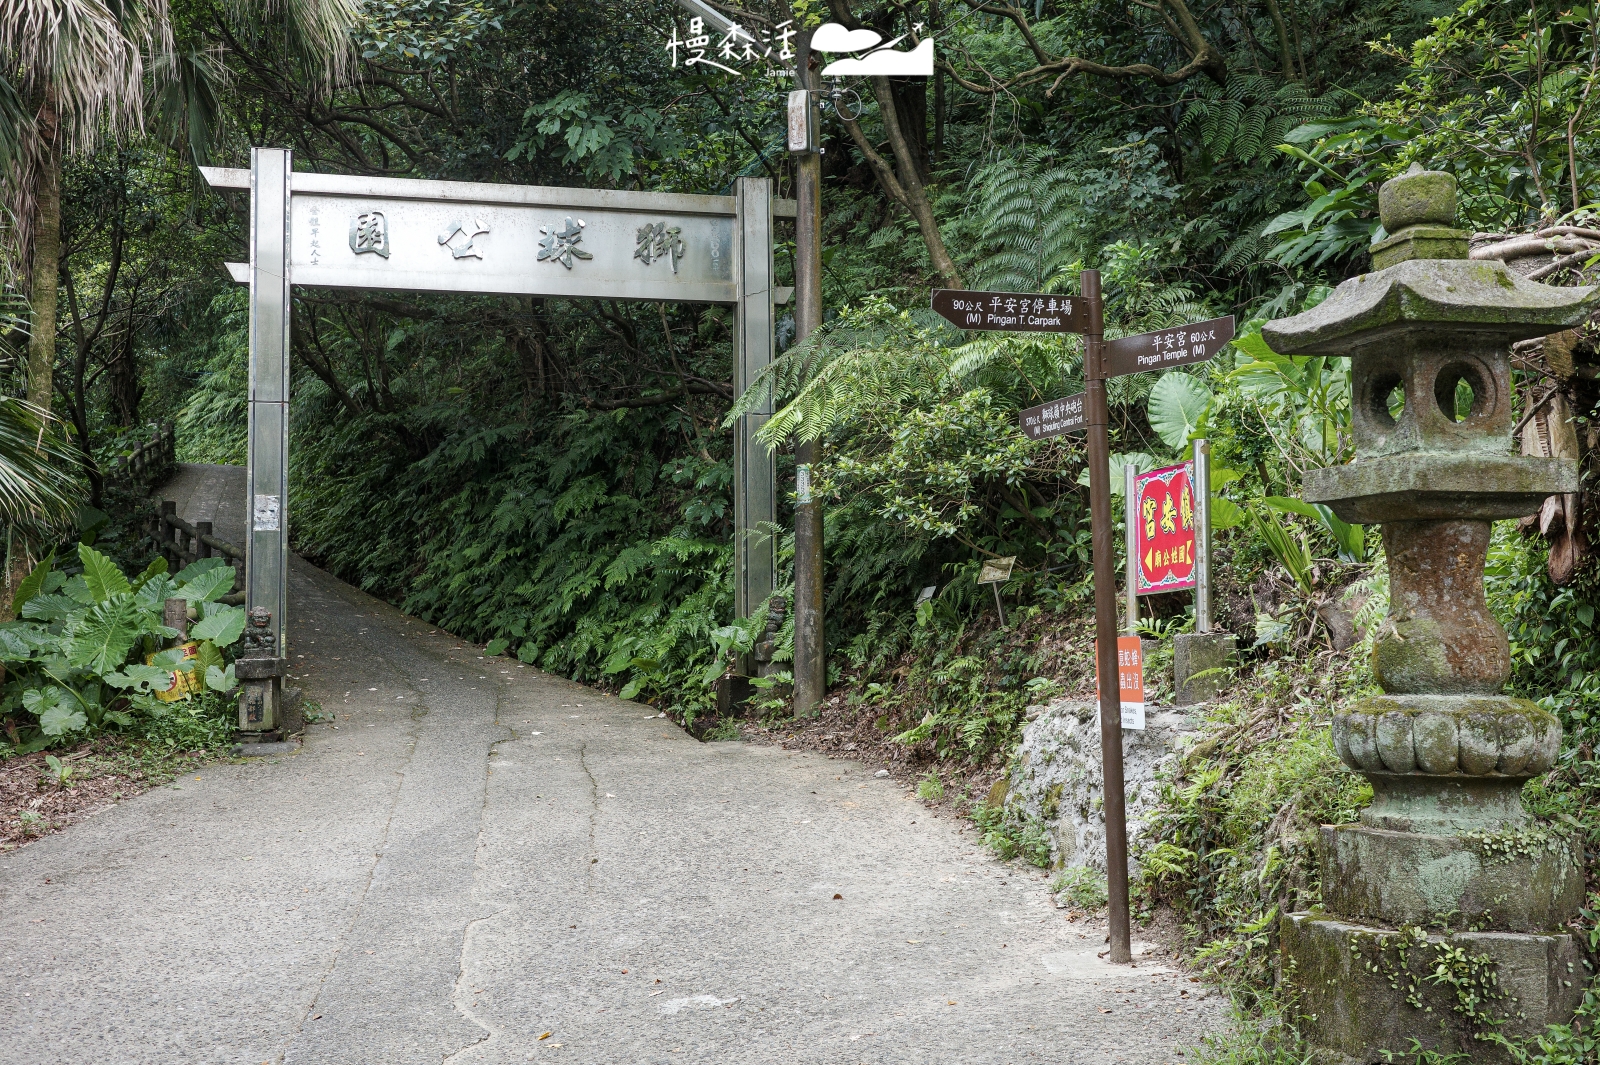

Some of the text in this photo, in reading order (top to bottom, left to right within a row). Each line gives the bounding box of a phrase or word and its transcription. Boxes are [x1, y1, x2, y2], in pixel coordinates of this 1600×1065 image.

[953, 296, 1073, 316] 90公尺 平安宮停車場
[966, 313, 1061, 327] (M) Pingan T. Carpark
[1152, 329, 1216, 352] 平安宮 60公尺
[1137, 343, 1206, 366] Pingan Temple (M)
[1060, 417, 1074, 428] Central
[1074, 414, 1083, 424] Fort
